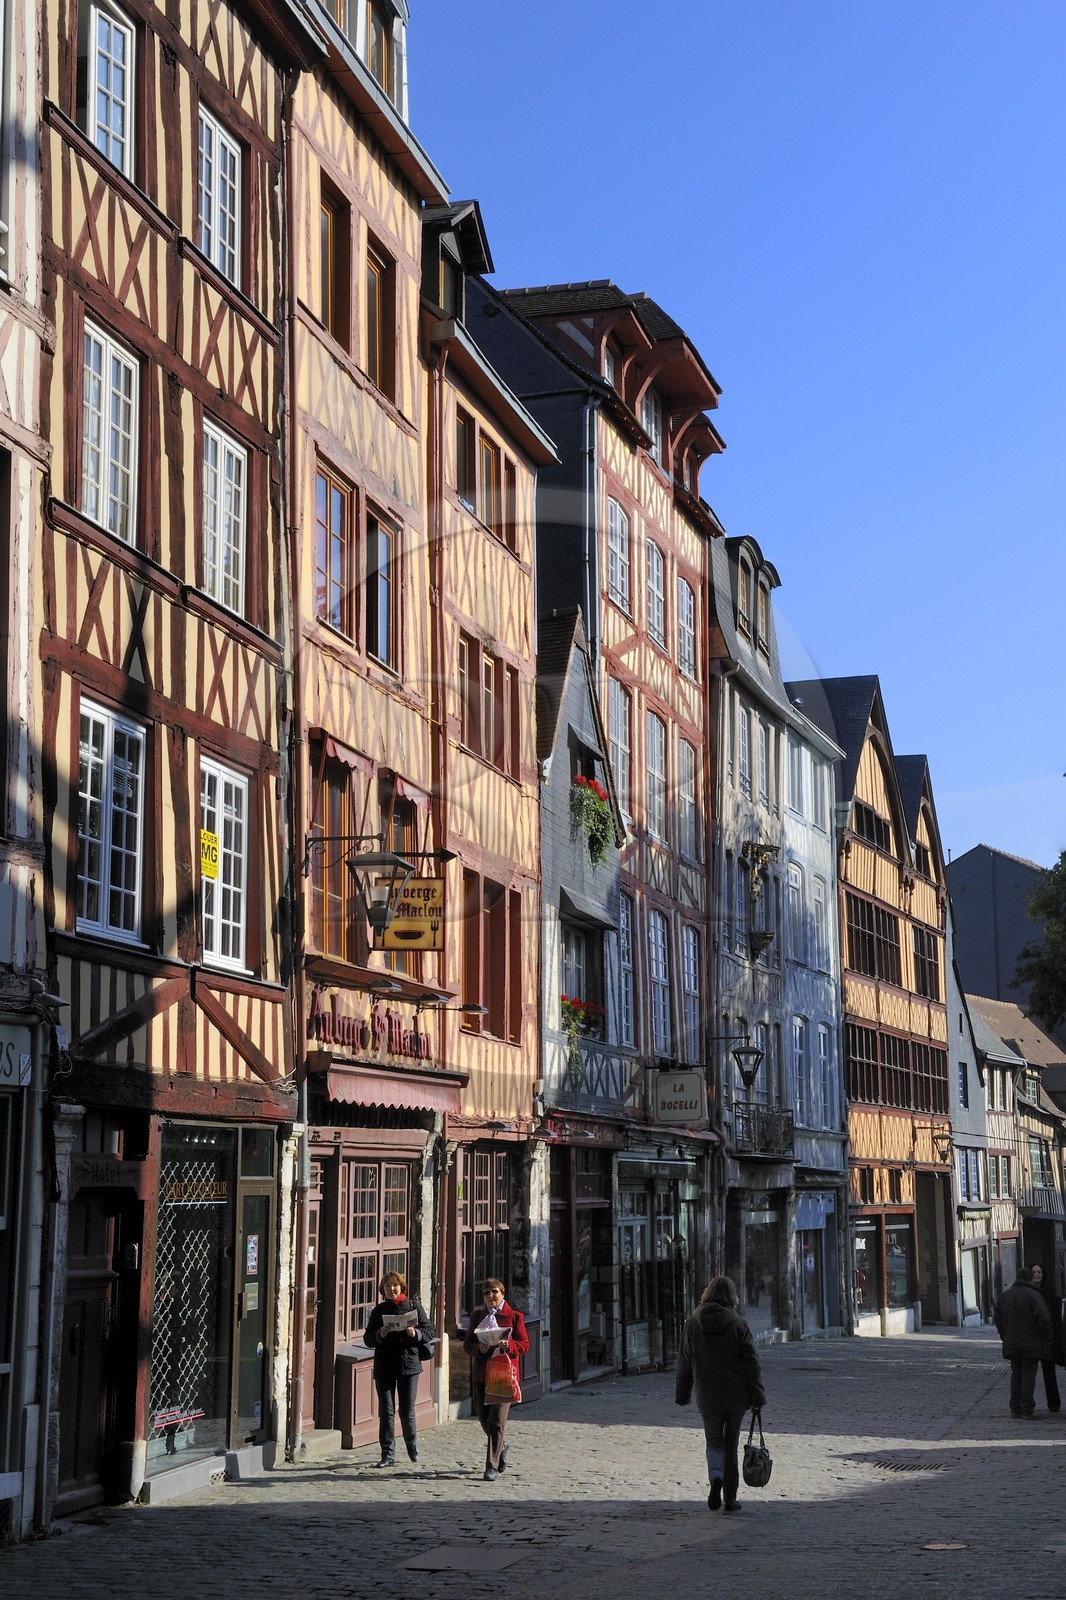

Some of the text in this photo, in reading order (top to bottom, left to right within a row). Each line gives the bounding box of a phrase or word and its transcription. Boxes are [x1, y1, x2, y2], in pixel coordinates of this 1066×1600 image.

[395, 903, 442, 918] Maclou
[672, 1083, 685, 1093] LA
[660, 1100, 698, 1110] BOCELLI
